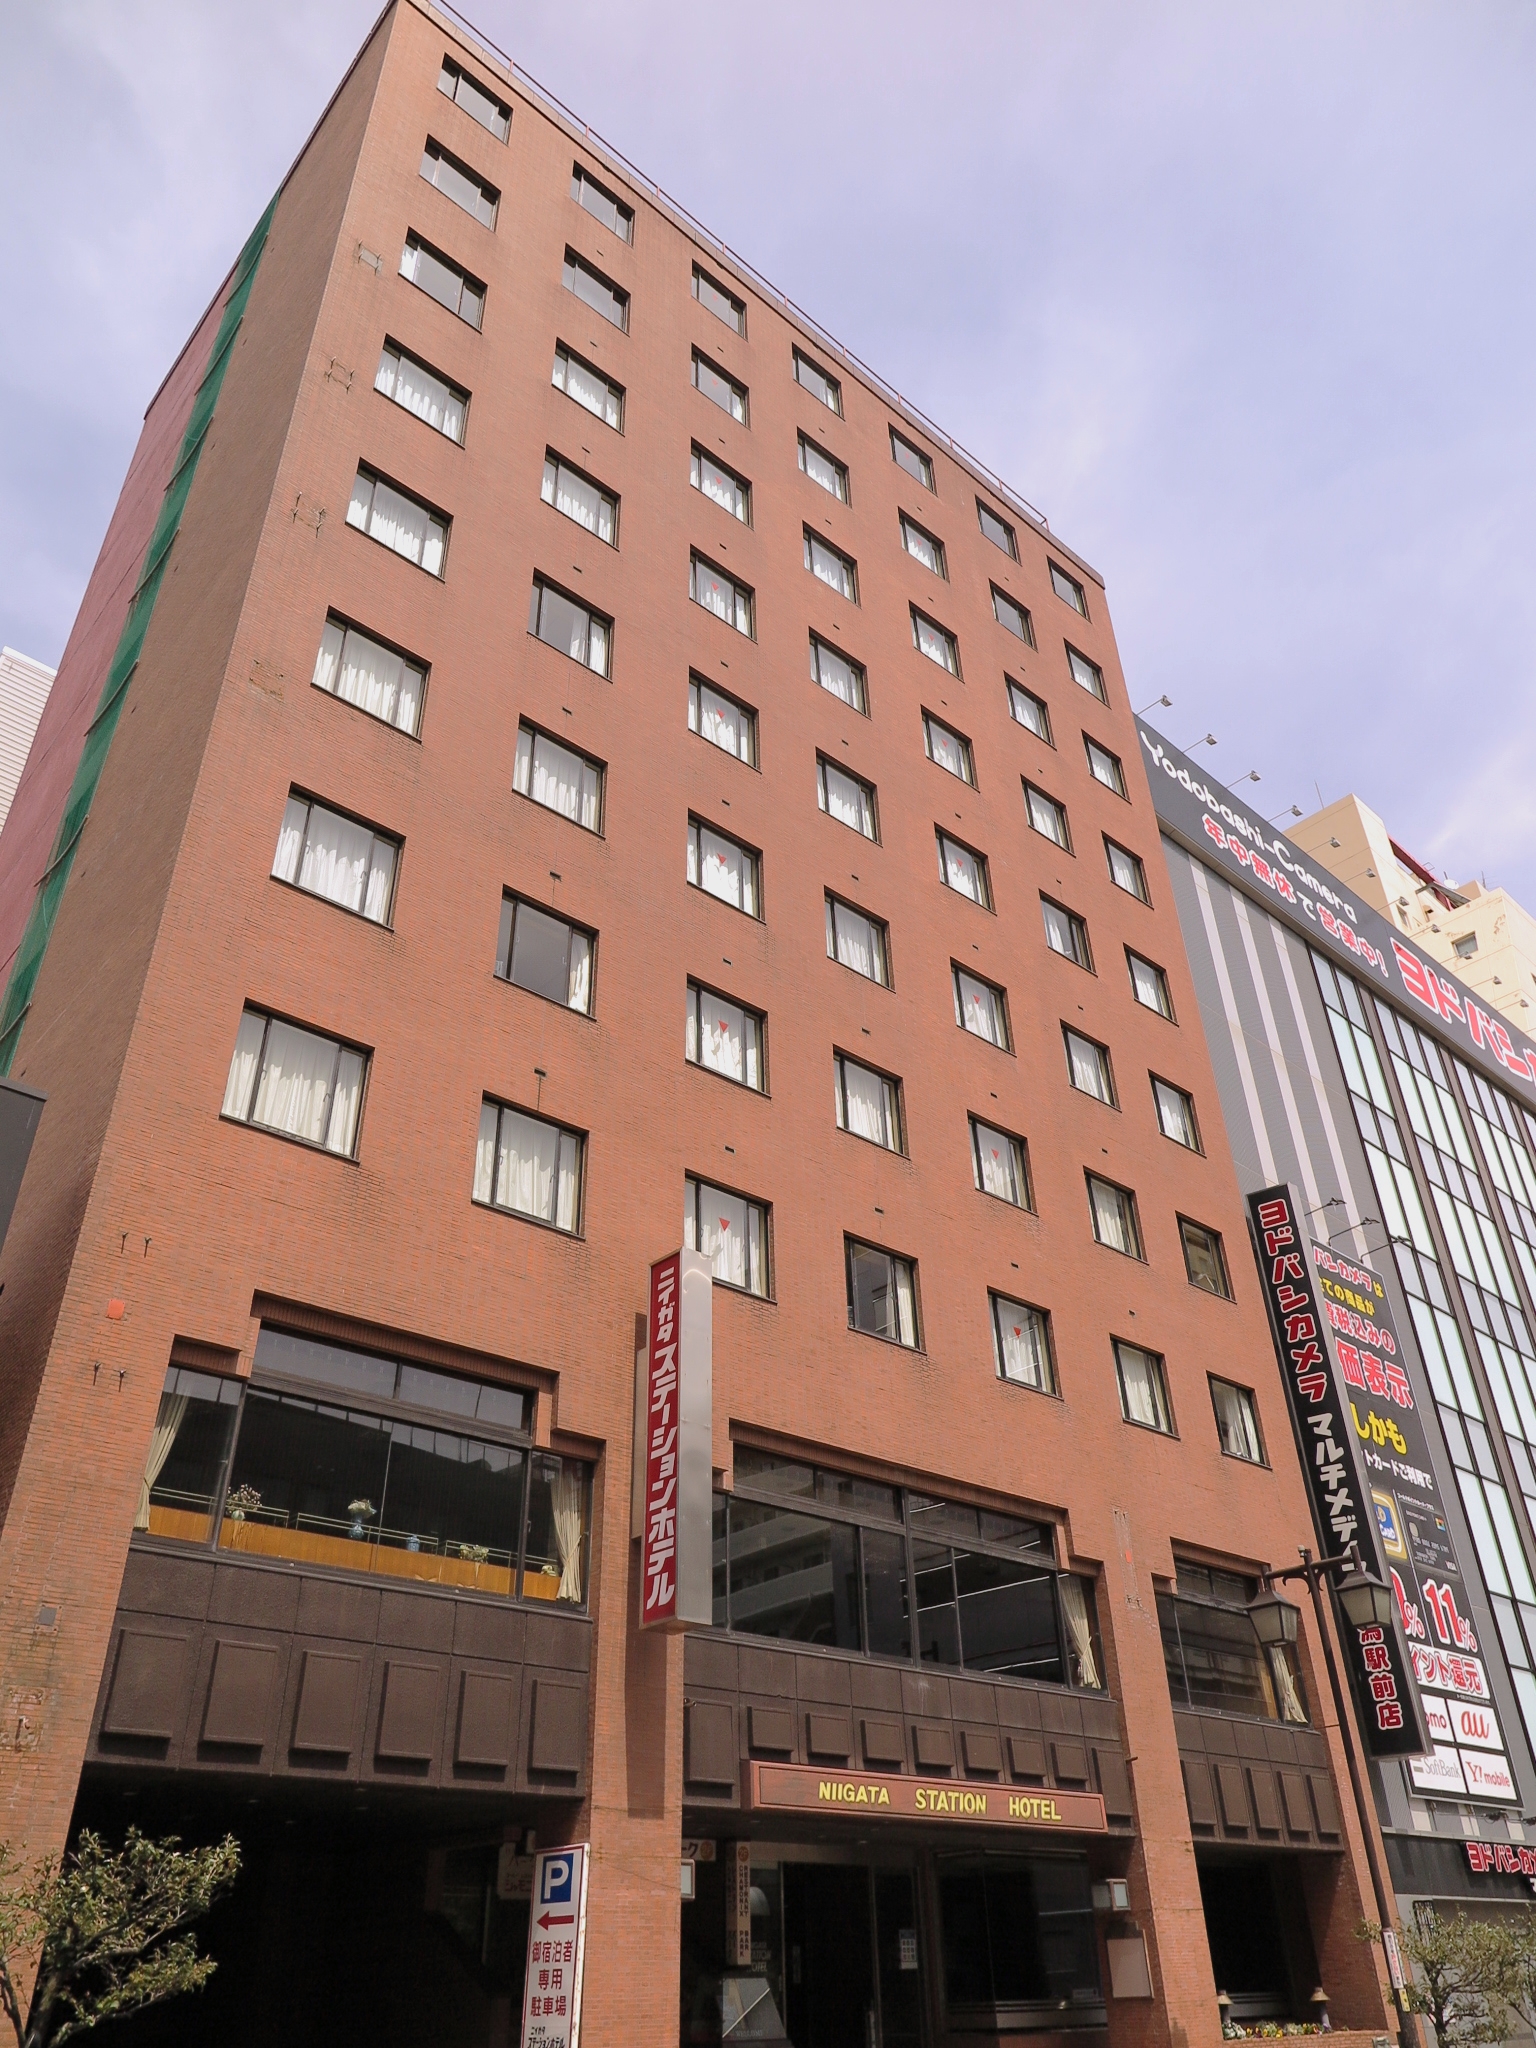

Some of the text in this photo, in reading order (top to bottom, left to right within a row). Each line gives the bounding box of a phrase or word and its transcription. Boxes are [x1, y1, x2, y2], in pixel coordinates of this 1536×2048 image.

[1140, 730, 1358, 923] Yodobashi-Camera
[1201, 813, 1389, 978] 年中無休で営業中!
[1390, 937, 1536, 1090] ヨドバシ
[1259, 1199, 1328, 1402] ヨドバシカメラ
[646, 1266, 678, 1611] ニイガタステーションホテル
[1350, 1402, 1407, 1454] しかも
[1361, 1449, 1434, 1490] トカードご利用で
[1422, 1577, 1478, 1653] 11%
[1461, 1711, 1490, 1739] au
[1424, 1757, 1462, 1778] SoftBank
[818, 1780, 1062, 1821] NIIGATA STATION HOTEL
[544, 1859, 569, 1900] P
[532, 1940, 573, 1963] 御宿泊者
[537, 1969, 563, 1990] 専用
[530, 1995, 566, 2017] 駐車場
